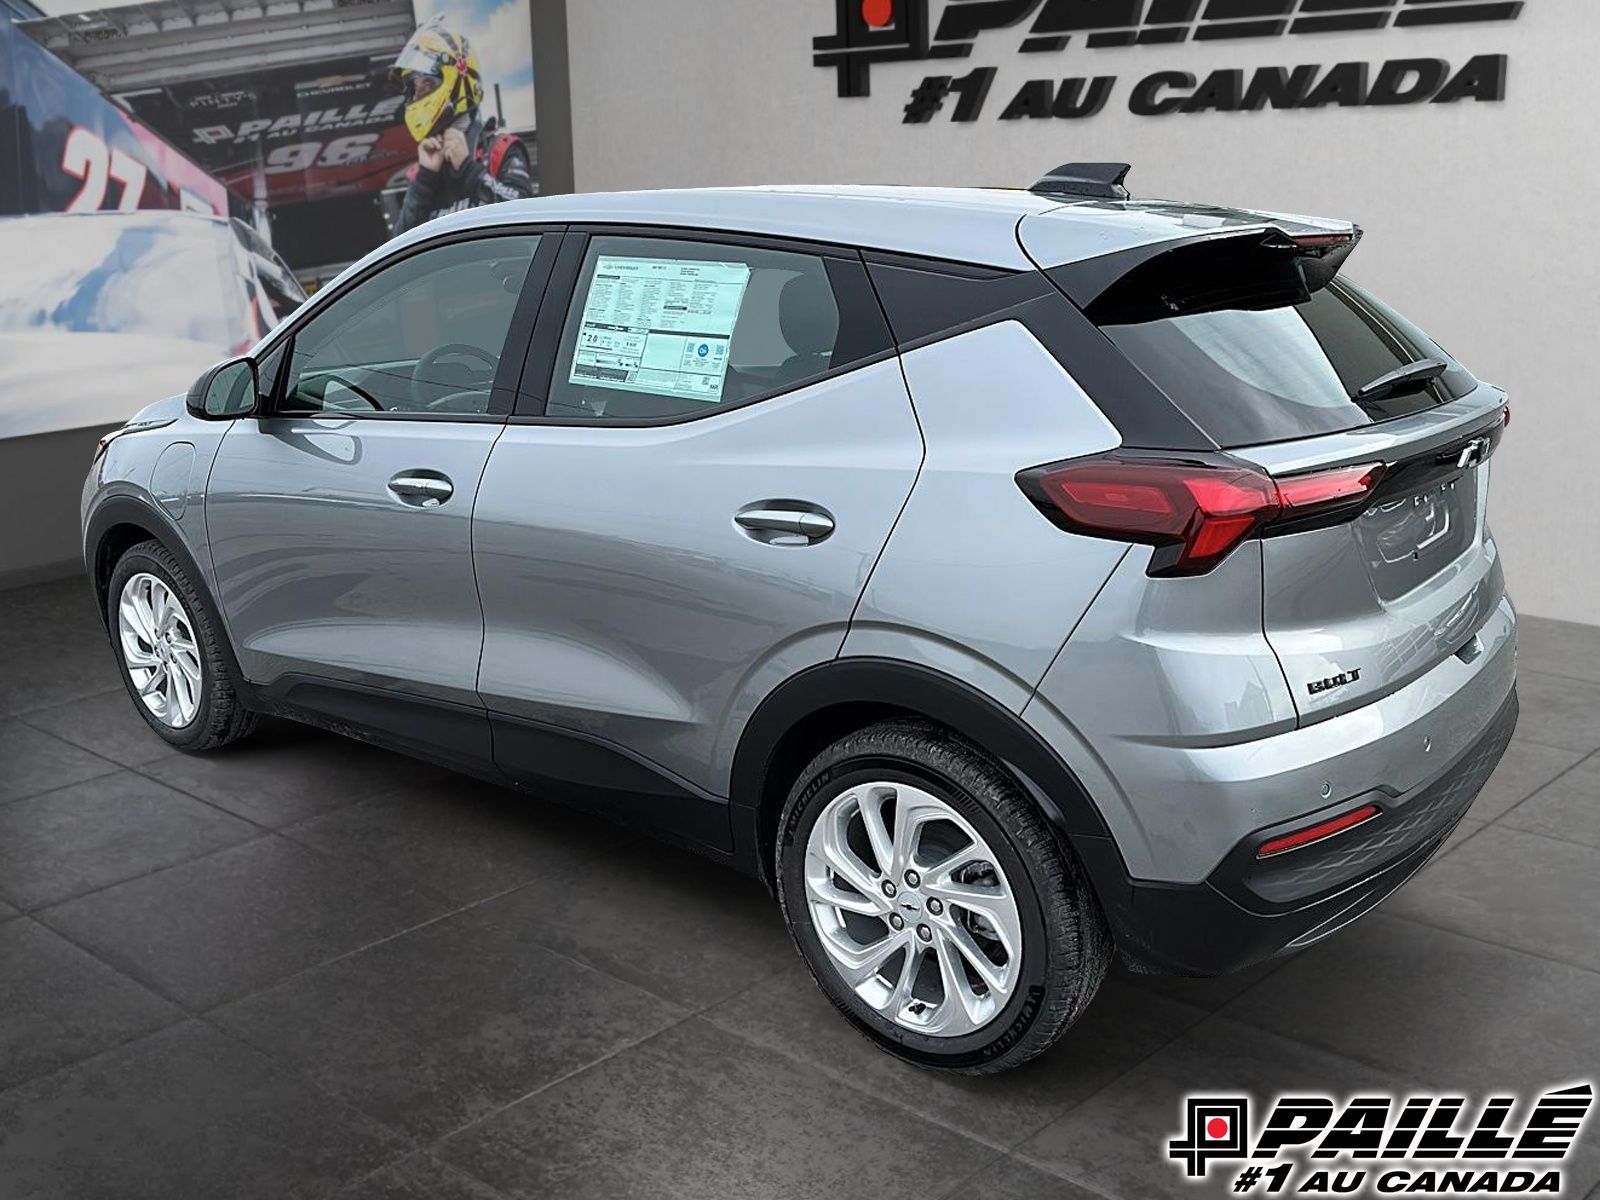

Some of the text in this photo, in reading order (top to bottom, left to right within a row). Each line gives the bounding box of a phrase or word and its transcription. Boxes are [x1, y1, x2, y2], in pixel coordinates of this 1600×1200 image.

[902, 54, 1508, 124] #1 AU CANADA
[62, 125, 148, 213] 27
[264, 133, 380, 176] 96
[1306, 668, 1361, 695] BOLT
